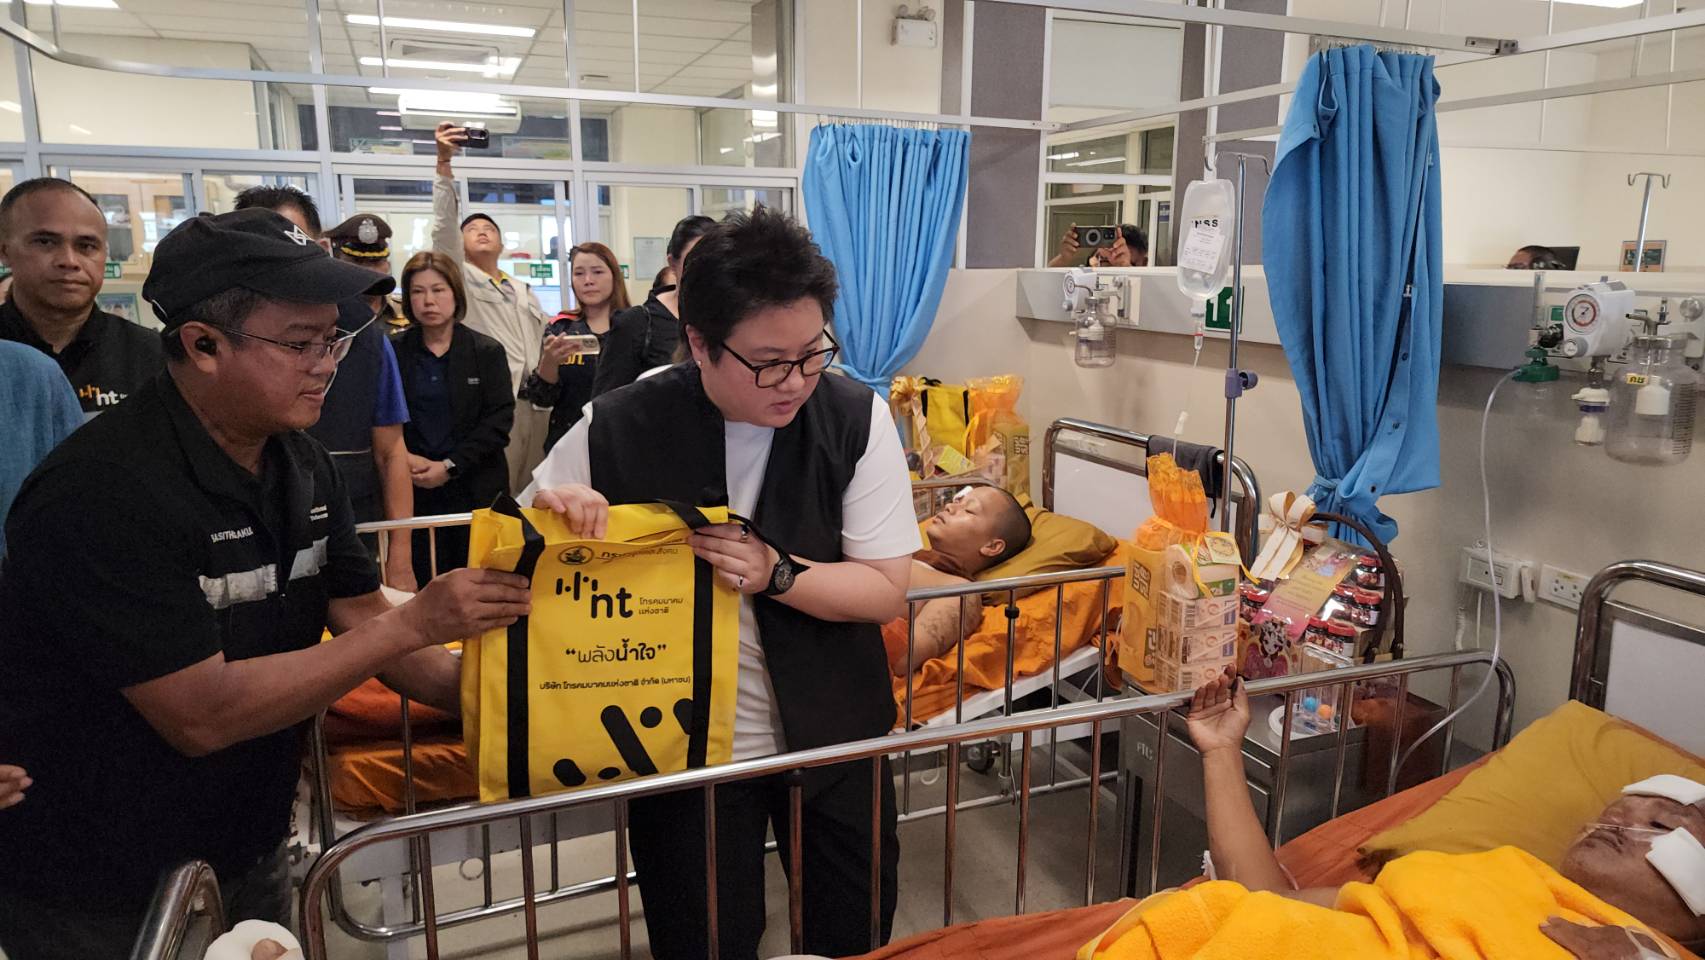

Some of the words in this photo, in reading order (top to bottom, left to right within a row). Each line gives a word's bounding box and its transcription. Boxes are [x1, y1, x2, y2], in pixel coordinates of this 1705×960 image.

[591, 587, 633, 619] nt
[639, 597, 684, 605] โทรคมนาคม
[638, 606, 670, 615] แห่งชาติ
[539, 681, 561, 690] บริษัท
[563, 678, 639, 689] โทรคมนาคมแห่งชาติ
[641, 677, 660, 686] จำกัด
[661, 676, 691, 685] (มหาชน)
